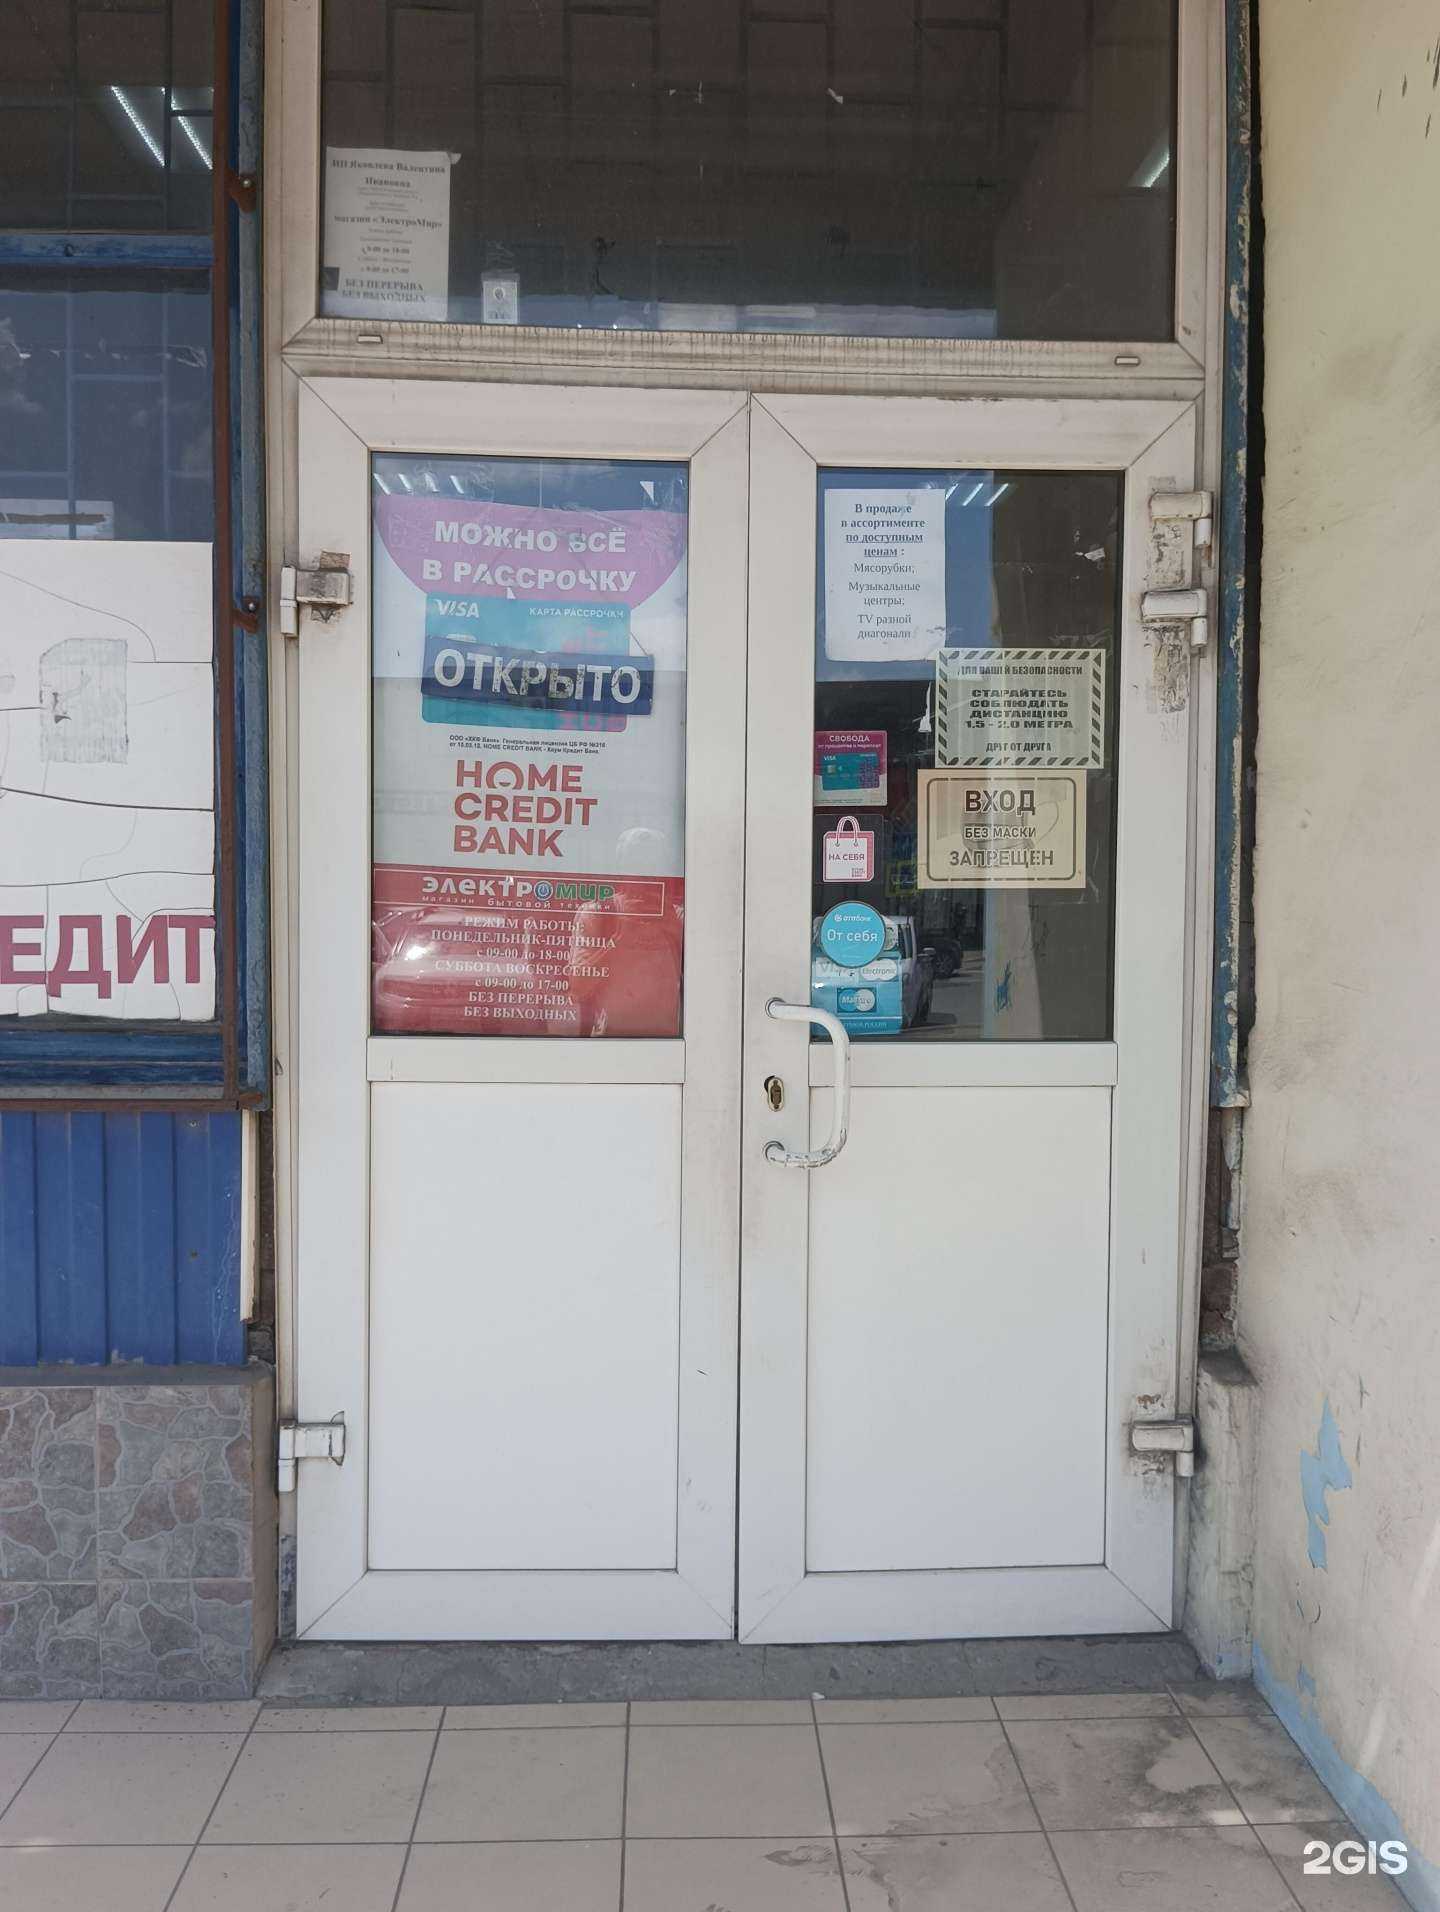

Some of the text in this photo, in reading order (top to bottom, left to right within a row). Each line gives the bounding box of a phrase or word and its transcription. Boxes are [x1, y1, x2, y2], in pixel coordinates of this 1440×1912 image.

[855, 503, 862, 513] В
[851, 520, 926, 530] ассортименте
[434, 520, 557, 552] МОЖНО
[846, 534, 923, 544] по доступным
[864, 548, 897, 557] ценам
[422, 558, 637, 592] В РАССРОЧКУ
[848, 581, 921, 593] Музыкальные
[434, 599, 480, 618] VISA
[529, 607, 561, 616] КАРТА
[876, 614, 912, 626] разной
[857, 629, 911, 640] диагонали
[434, 648, 641, 704] ОТКРЫТО
[1012, 666, 1083, 675] БЕЗОПАСНОСТИ
[971, 688, 1067, 698] СТАРАЙТЕСЬ
[969, 700, 1069, 709] СОБЛЮДАТЬ
[969, 710, 1068, 719] ДИСТАНЦИЮ
[1023, 720, 1073, 729] МЕТРА
[1010, 742, 1022, 751] ОТ
[1023, 742, 1052, 752] ДРУГА
[456, 760, 583, 793] HOME
[965, 790, 1035, 815] ВХОД
[454, 793, 598, 826] CREDIT
[965, 828, 1036, 838] БЕЗ МАСКИ
[453, 825, 564, 857] BANK
[828, 853, 865, 861] НА СЕБЯ
[950, 850, 1053, 868] ЗАПРЕЩЕН
[487, 898, 552, 909] бытовой
[464, 916, 519, 929] РЕЖИМ
[431, 929, 616, 948] ПОНЕДЕЛЬНИК-ПЯТНИЦА
[827, 929, 878, 942] От себя
[0, 915, 215, 999] ЕДИТ
[486, 948, 518, 958] 09-00
[539, 950, 570, 961] 18-00
[435, 960, 610, 978] СУББОТА ВОСКРЕСЕНЬЕ
[484, 978, 517, 989] 09-00
[537, 980, 569, 991] 17-00
[469, 991, 574, 1007] БЕЗ ПЕРЕРЫВА
[464, 1006, 577, 1022] БЕЗ ВЫХОДНЫХ
